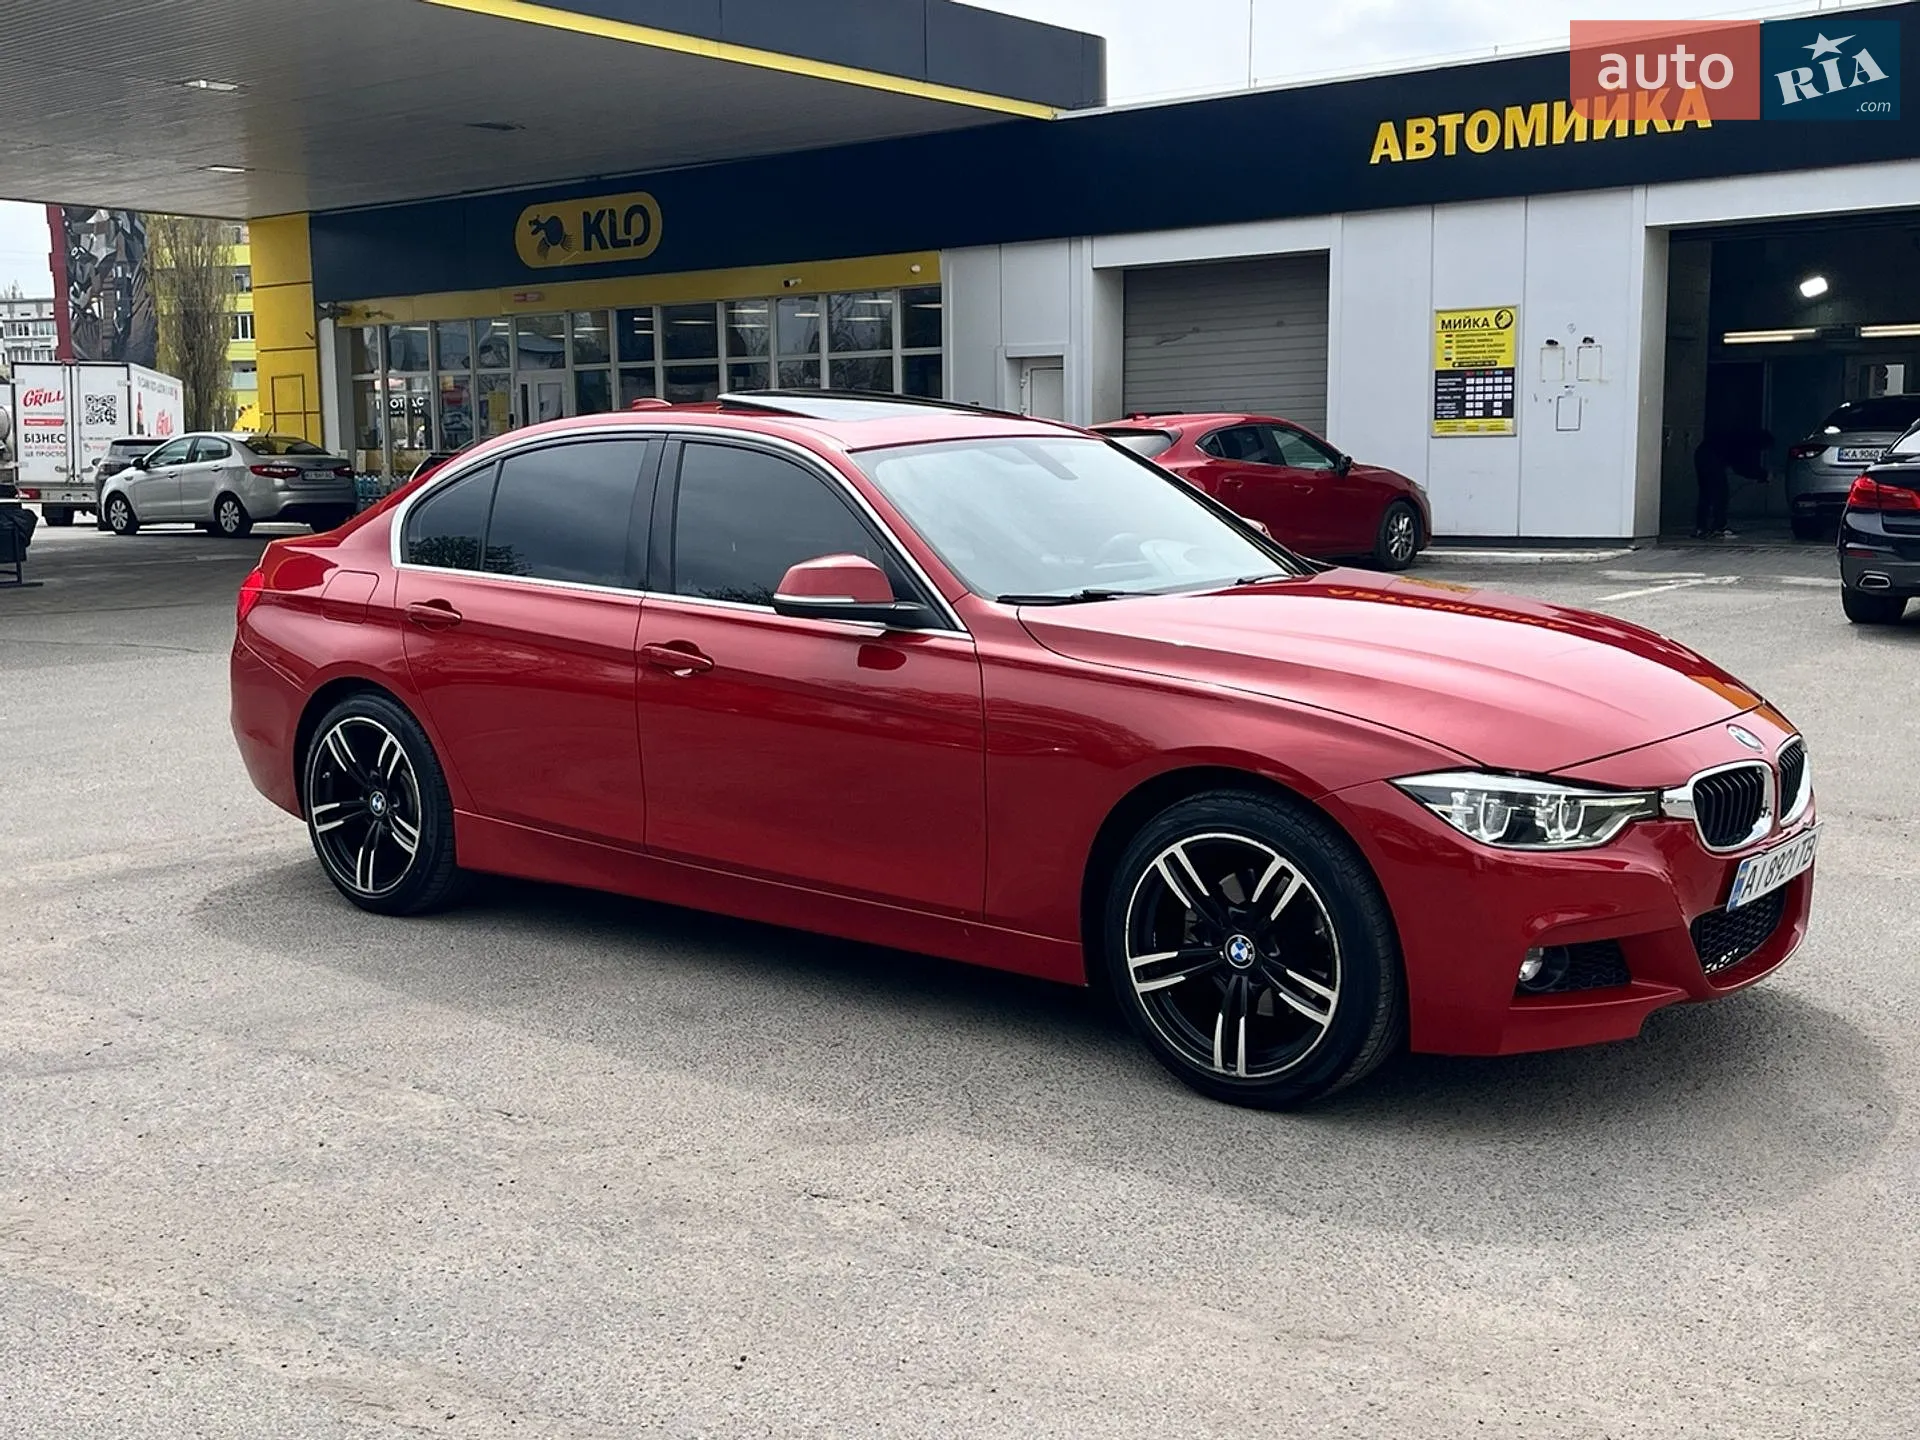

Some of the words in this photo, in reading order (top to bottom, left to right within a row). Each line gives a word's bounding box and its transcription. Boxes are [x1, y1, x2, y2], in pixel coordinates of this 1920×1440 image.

[1369, 83, 1713, 165] АВТОМИЙКА
[582, 203, 651, 252] KLO
[1441, 315, 1490, 330] МИЙКА
[23, 388, 65, 408] GRILL
[24, 433, 67, 444] БІЗНЕС
[1741, 860, 1768, 899] AI
[1763, 843, 1800, 888] 8921
